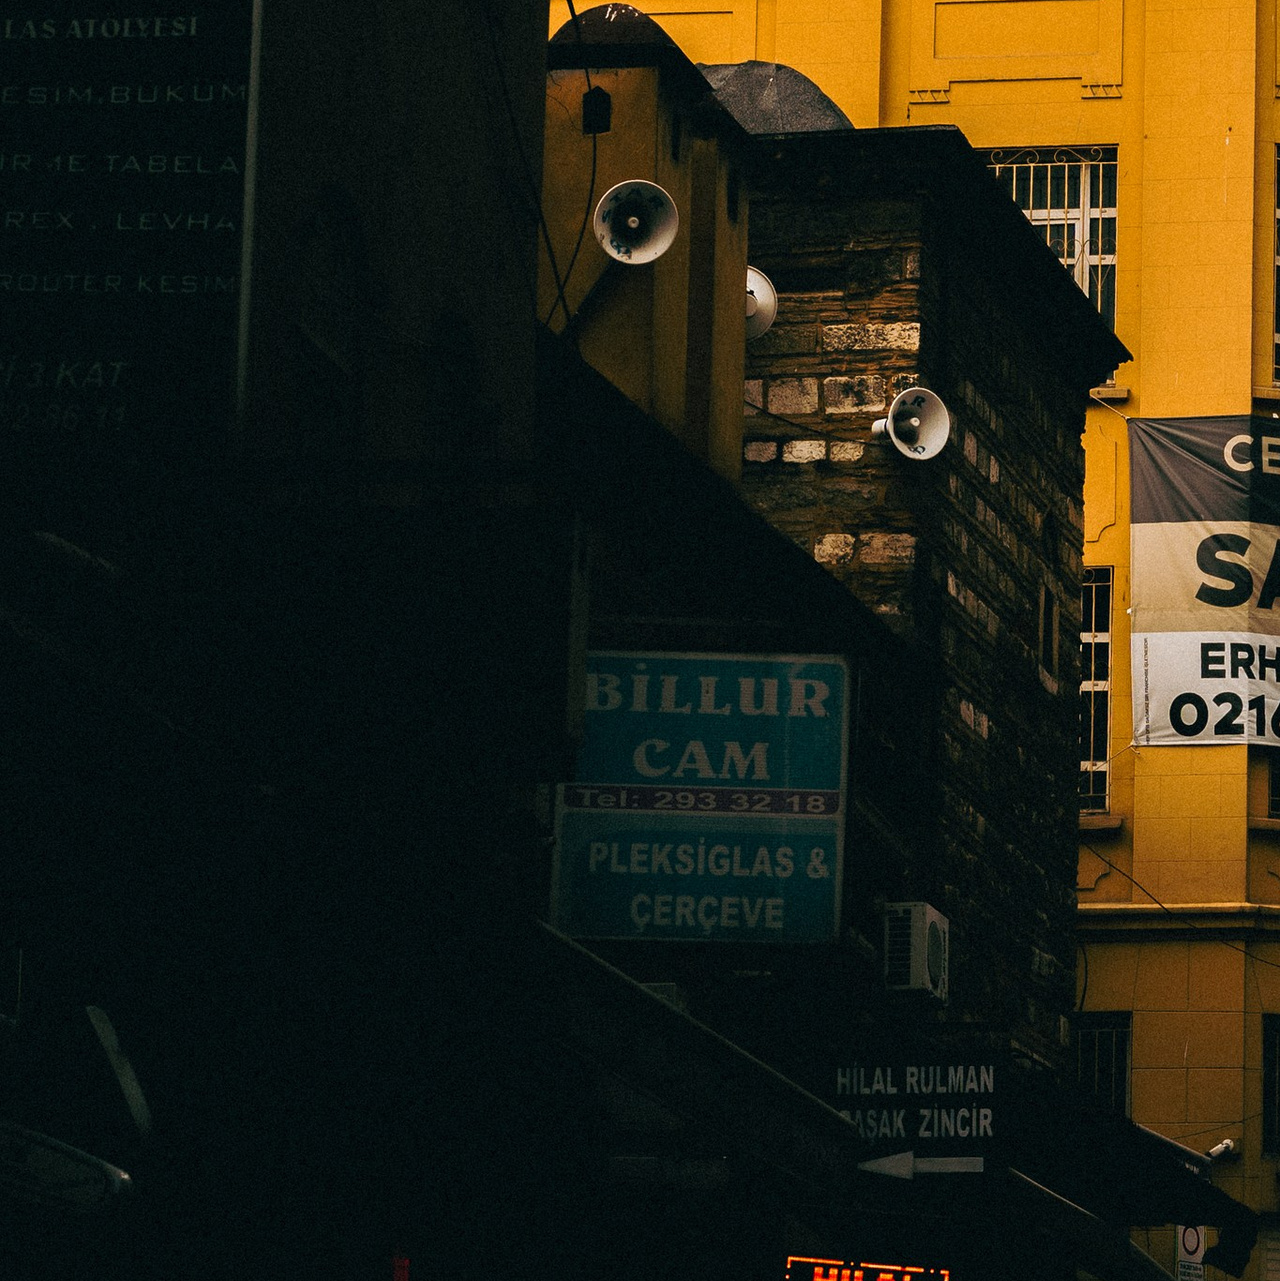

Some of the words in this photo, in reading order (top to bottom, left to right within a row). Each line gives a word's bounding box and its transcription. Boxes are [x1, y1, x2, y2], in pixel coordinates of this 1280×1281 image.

[585, 662, 832, 718] BİLLUR
[632, 738, 771, 781] CAM
[575, 788, 640, 809] Tel:
[654, 790, 718, 811] 293
[730, 793, 772, 812] 32
[785, 794, 827, 814] 18
[588, 837, 795, 879] PLEKSİGLAS
[805, 846, 830, 880] &
[629, 893, 785, 936] ÇERÇEVE
[836, 1061, 898, 1095] HİLAL
[905, 1064, 995, 1094] RULMAN
[918, 1102, 994, 1138] ZİNCİR
